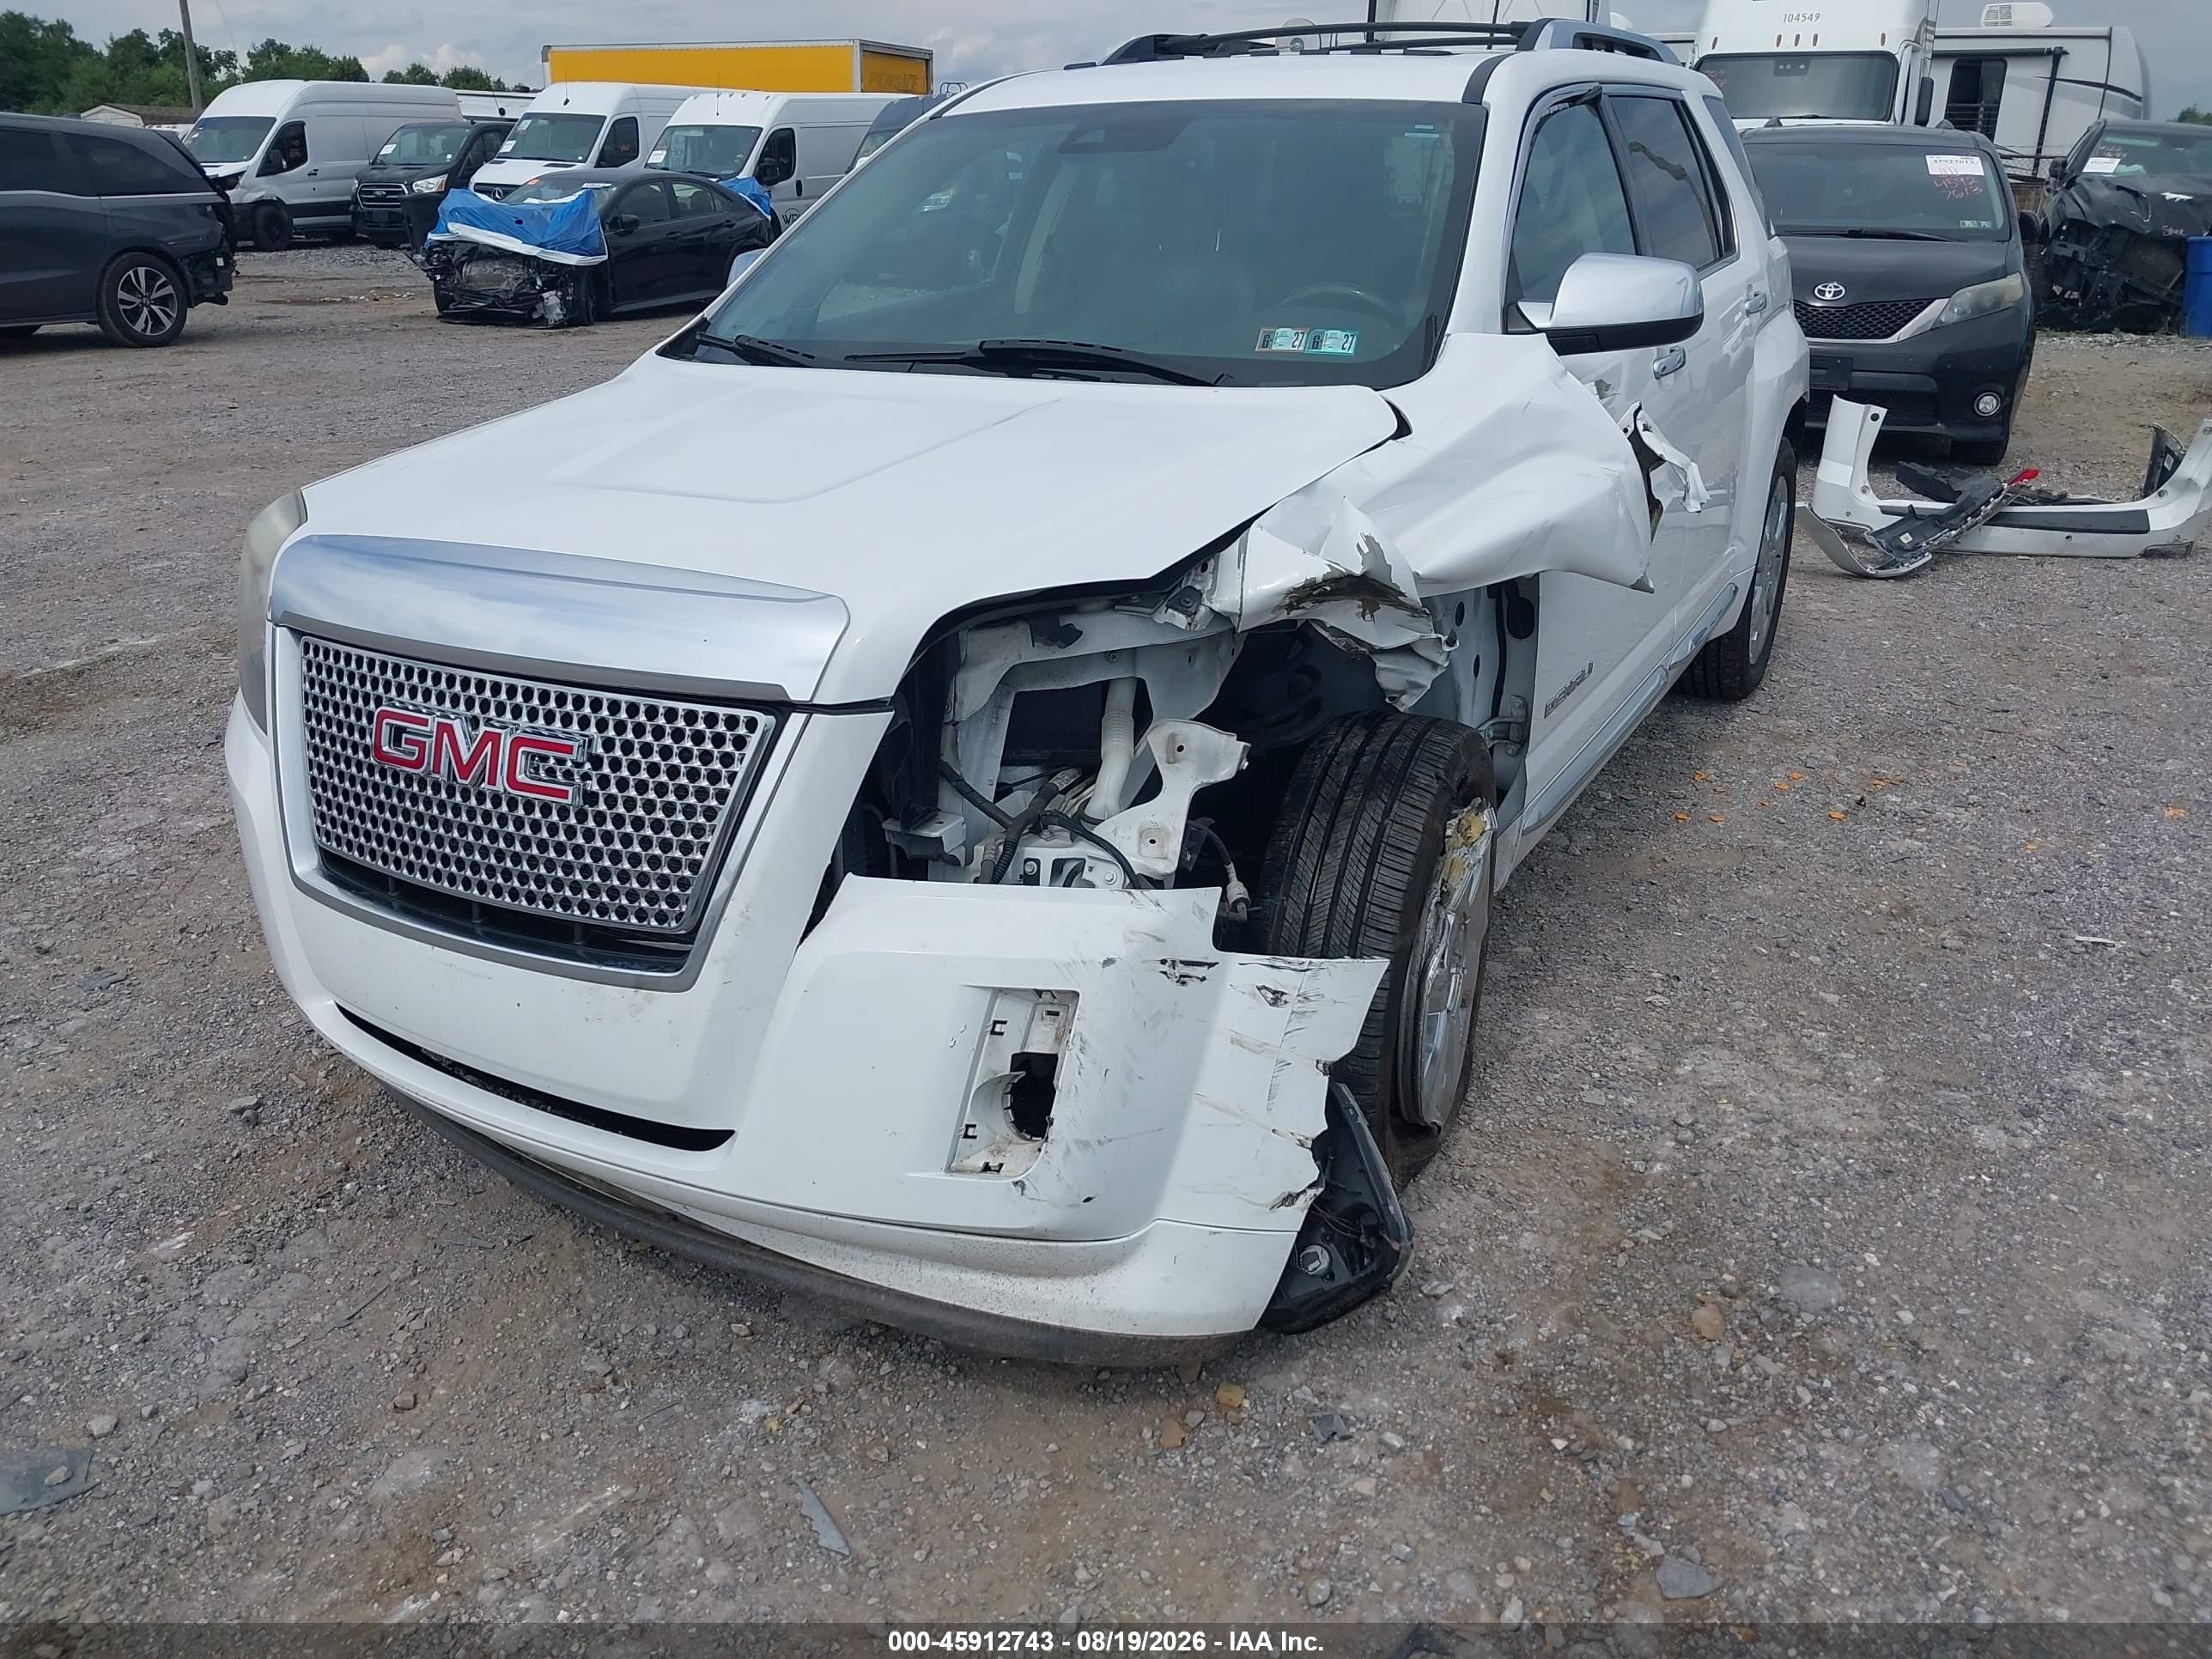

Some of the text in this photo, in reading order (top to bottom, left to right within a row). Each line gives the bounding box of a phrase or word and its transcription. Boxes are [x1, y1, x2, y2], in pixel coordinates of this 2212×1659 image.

[1784, 13, 1820, 23] 104549
[1291, 331, 1305, 349] 27
[1340, 333, 1355, 351] 27
[373, 706, 587, 805] GMC
